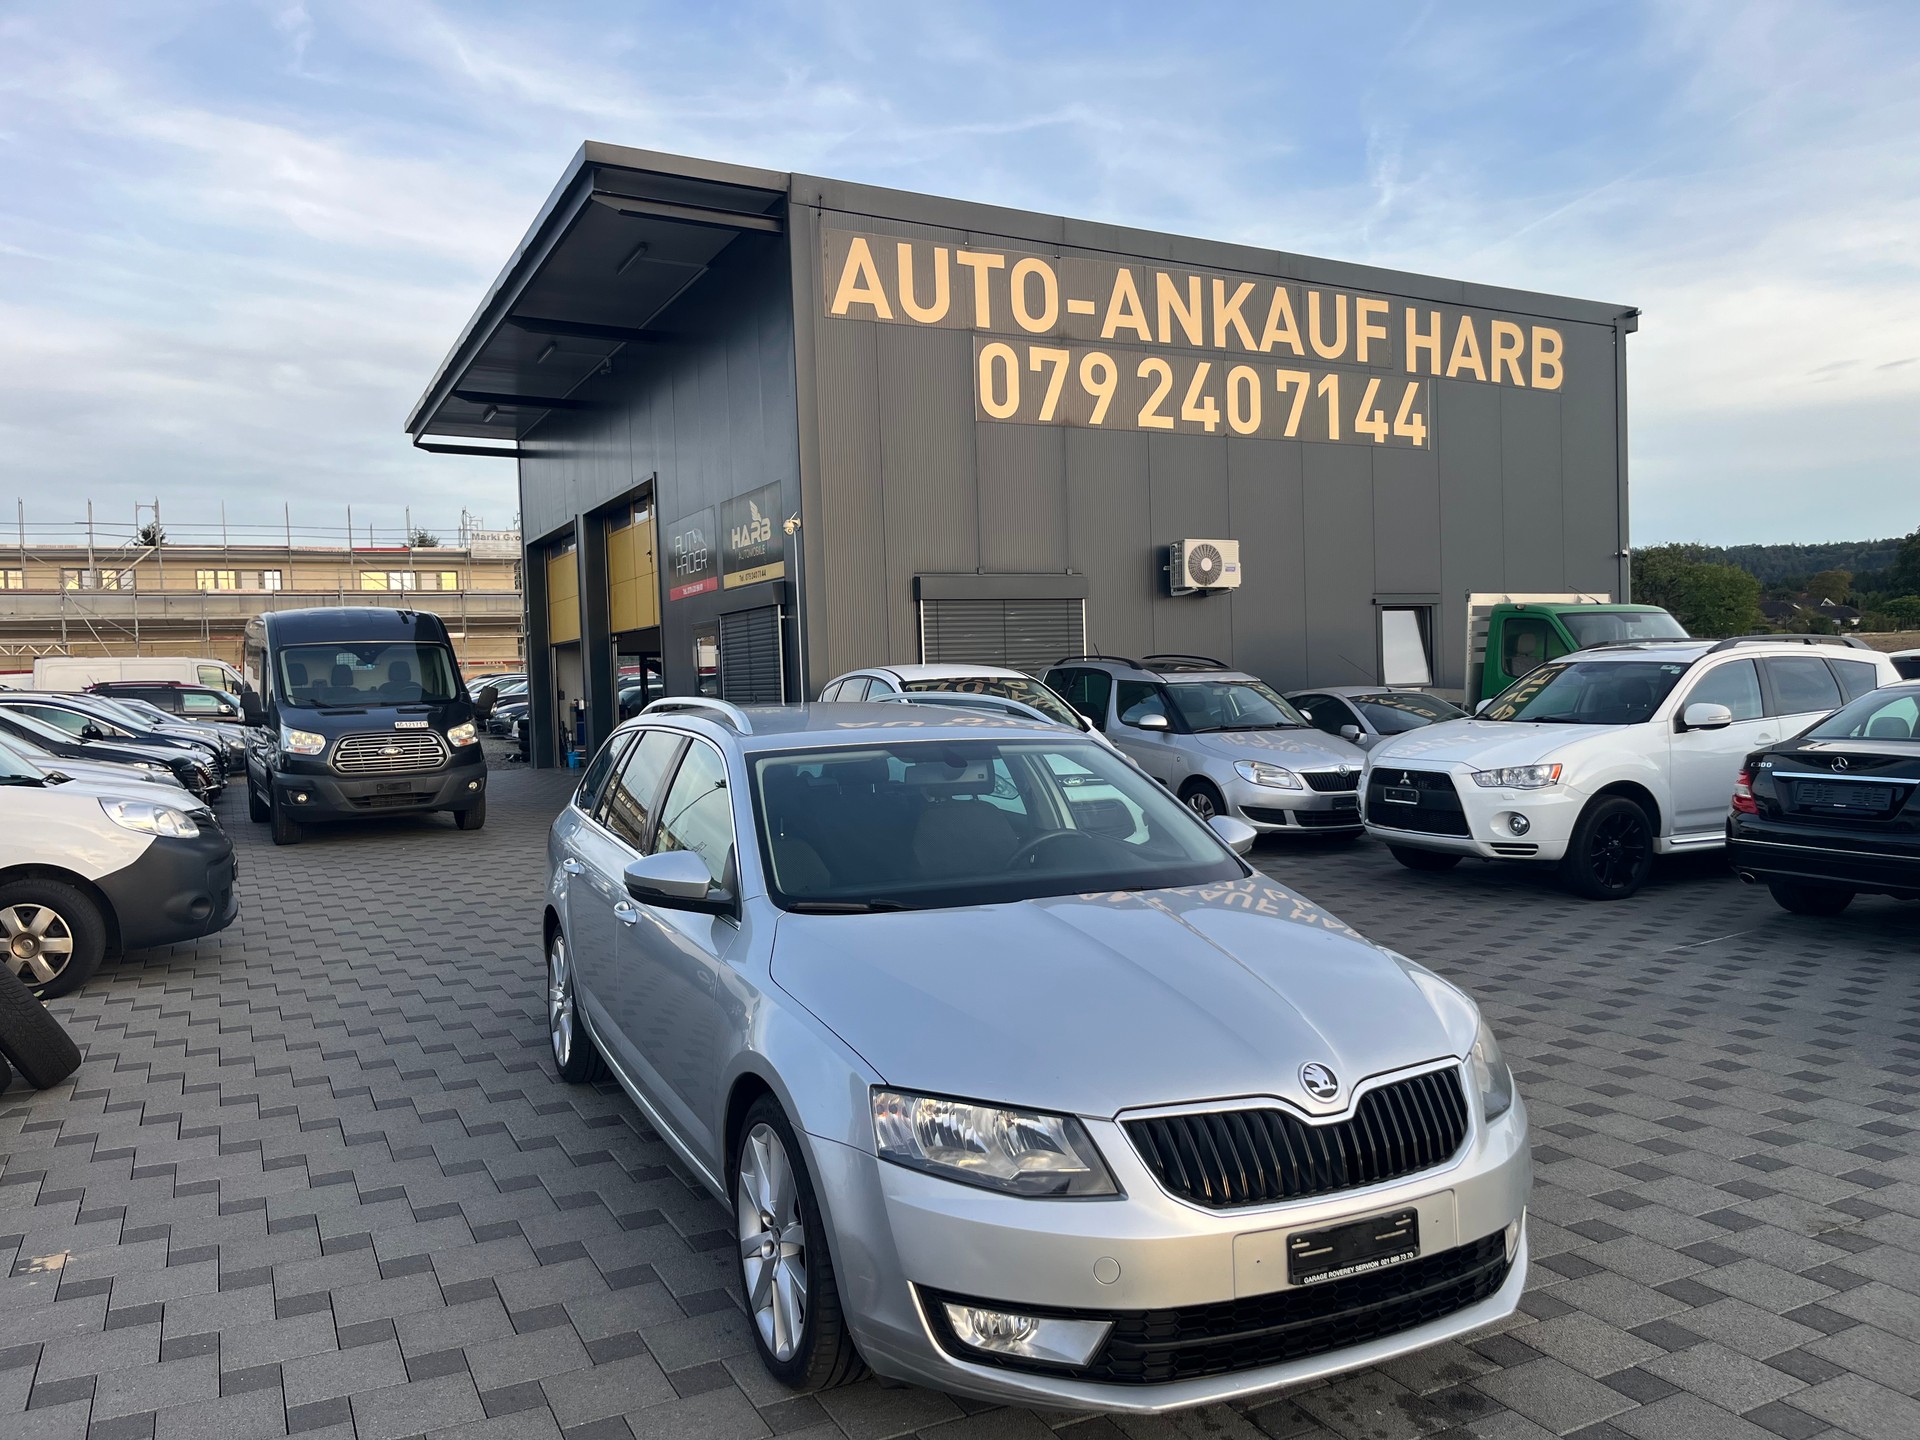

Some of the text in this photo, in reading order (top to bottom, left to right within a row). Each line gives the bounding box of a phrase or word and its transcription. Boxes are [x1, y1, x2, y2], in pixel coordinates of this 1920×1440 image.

[831, 237, 1564, 390] AUTO-ANKAUF HARB
[979, 342, 1118, 425] 079
[1137, 357, 1261, 435] 240
[471, 532, 500, 541] Marki
[731, 517, 771, 550] HARB
[1303, 1272, 1328, 1284] GARAGE
[1328, 1266, 1354, 1278] ROVEREY
[1355, 1261, 1379, 1272] SERVION
